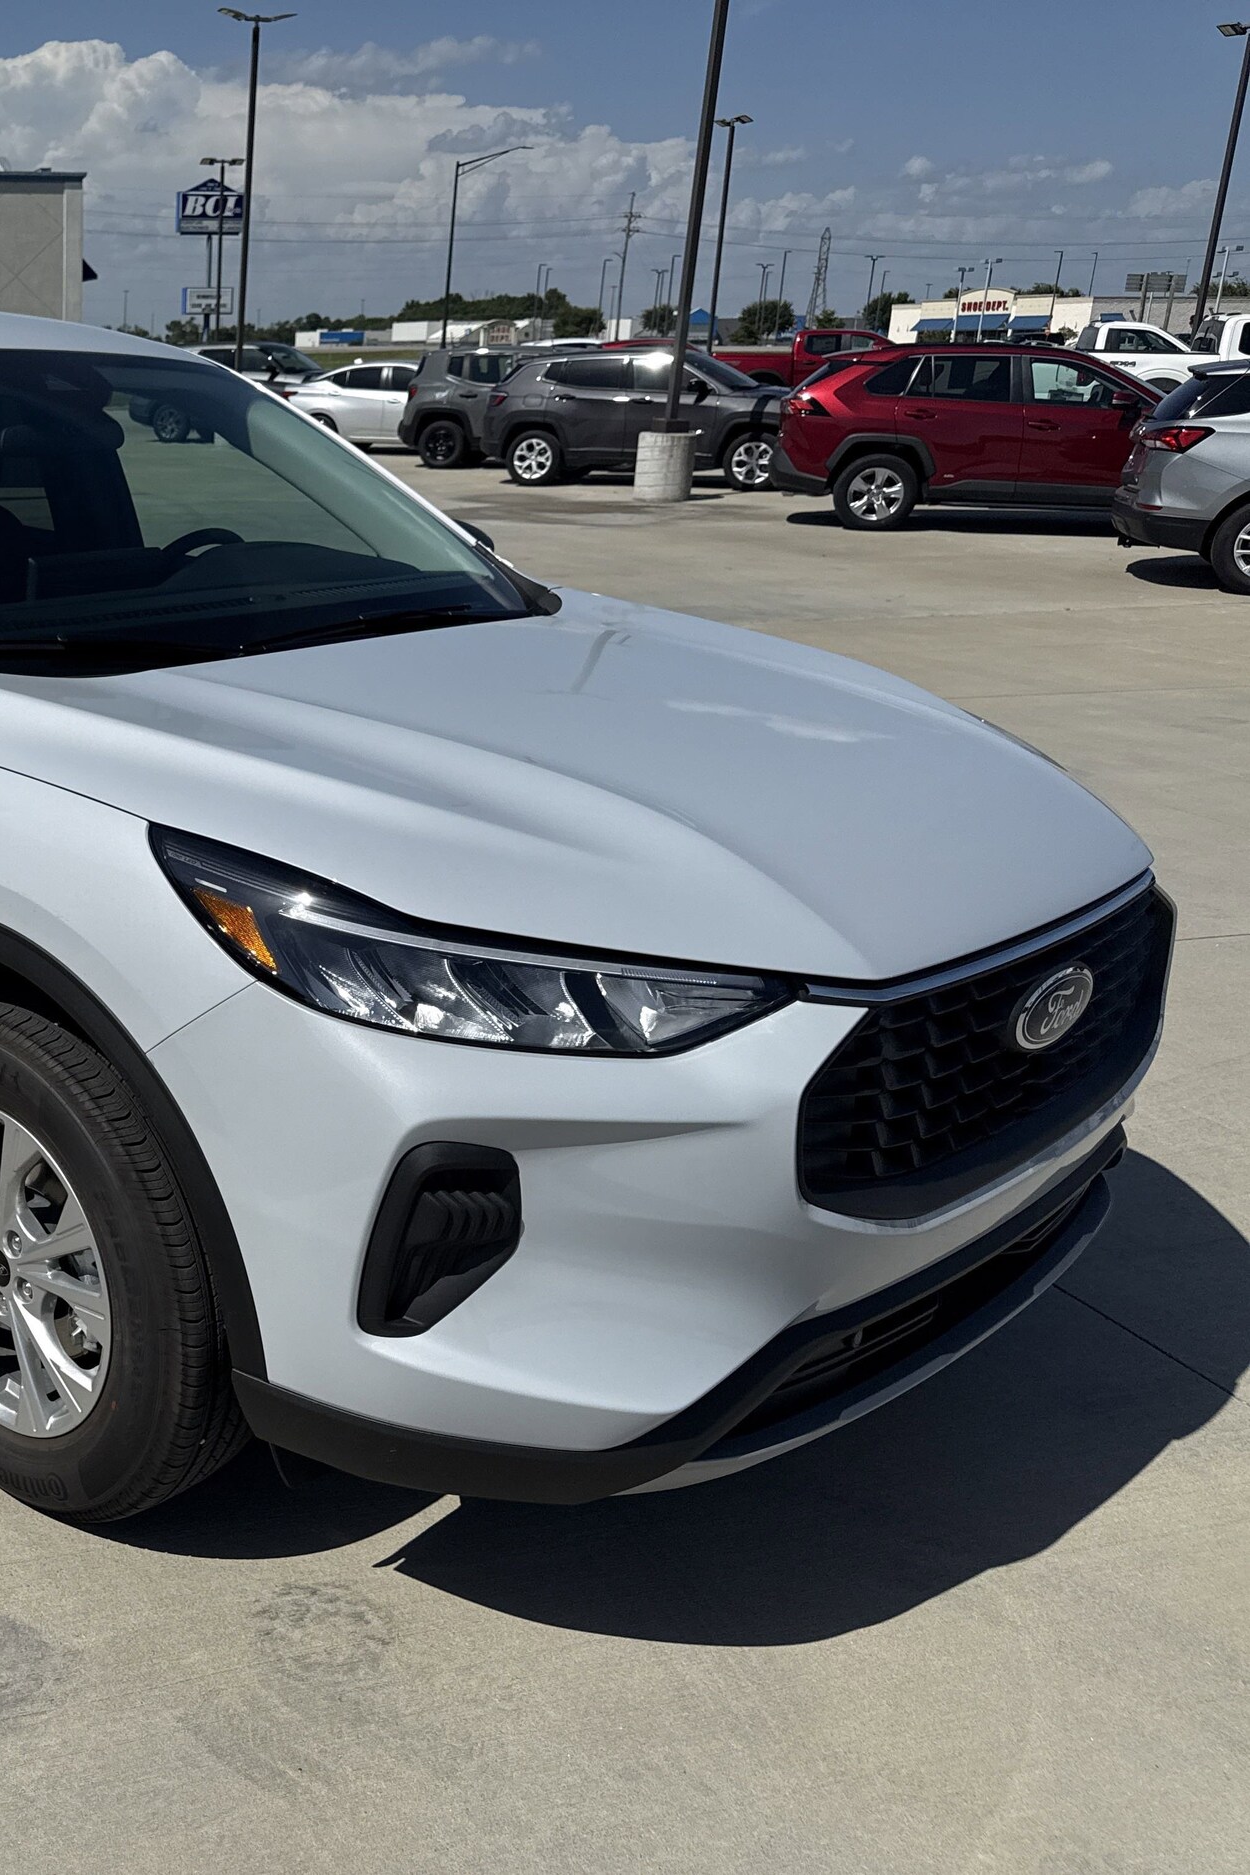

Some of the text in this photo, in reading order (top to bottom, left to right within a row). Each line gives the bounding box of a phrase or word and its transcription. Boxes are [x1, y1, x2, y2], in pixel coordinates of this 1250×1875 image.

[961, 300, 1009, 312] SHOE DEPT.
[1040, 985, 1084, 1035] Ford
